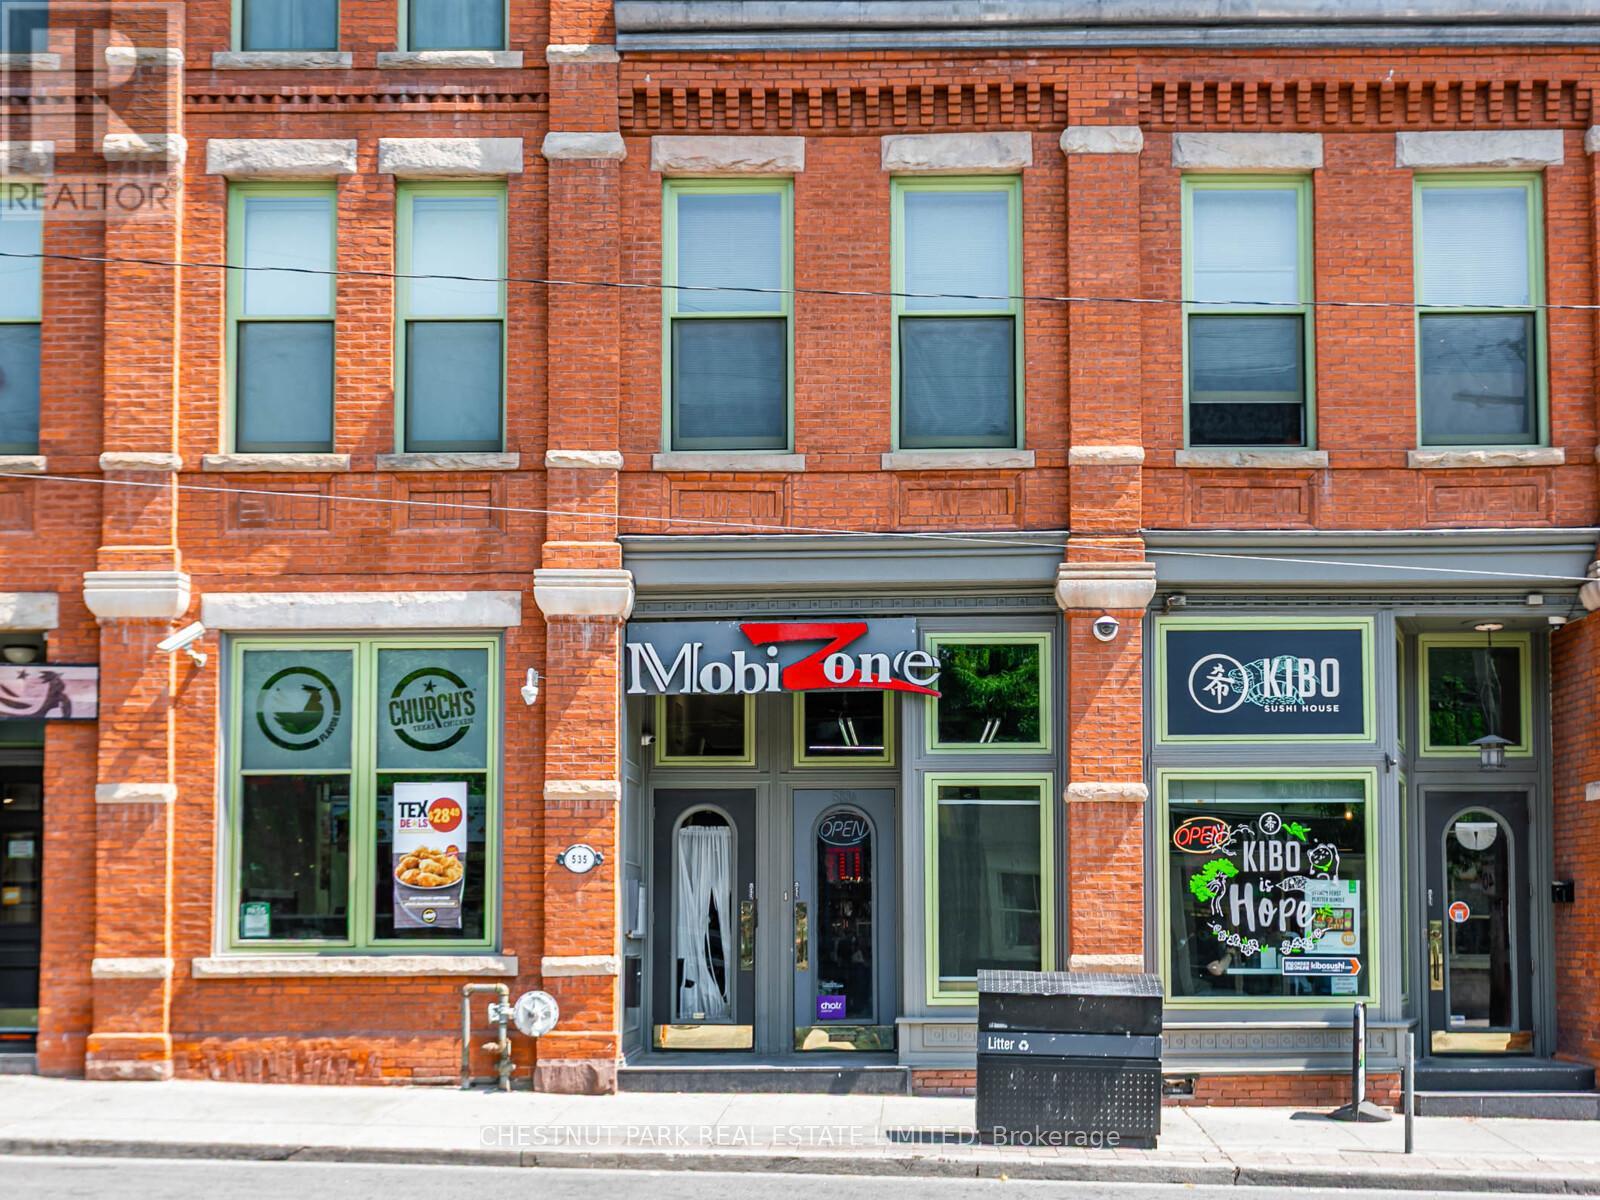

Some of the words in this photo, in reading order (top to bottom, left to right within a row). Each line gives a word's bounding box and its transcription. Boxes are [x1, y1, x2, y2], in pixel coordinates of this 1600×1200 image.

[626, 622, 942, 699] MobiZone
[1263, 658, 1340, 698] KIBO
[389, 689, 476, 728] CHURCH'S
[1264, 704, 1298, 713] SUSHI
[1302, 704, 1340, 713] HOUSE
[398, 800, 428, 818] TEX
[820, 820, 866, 838] OPEN
[1175, 826, 1226, 846] OPEN
[571, 855, 588, 864] 535
[1243, 840, 1301, 873] KIBO
[1259, 877, 1275, 892] is
[1229, 883, 1316, 932] Hope
[987, 1036, 1015, 1051] Litter
